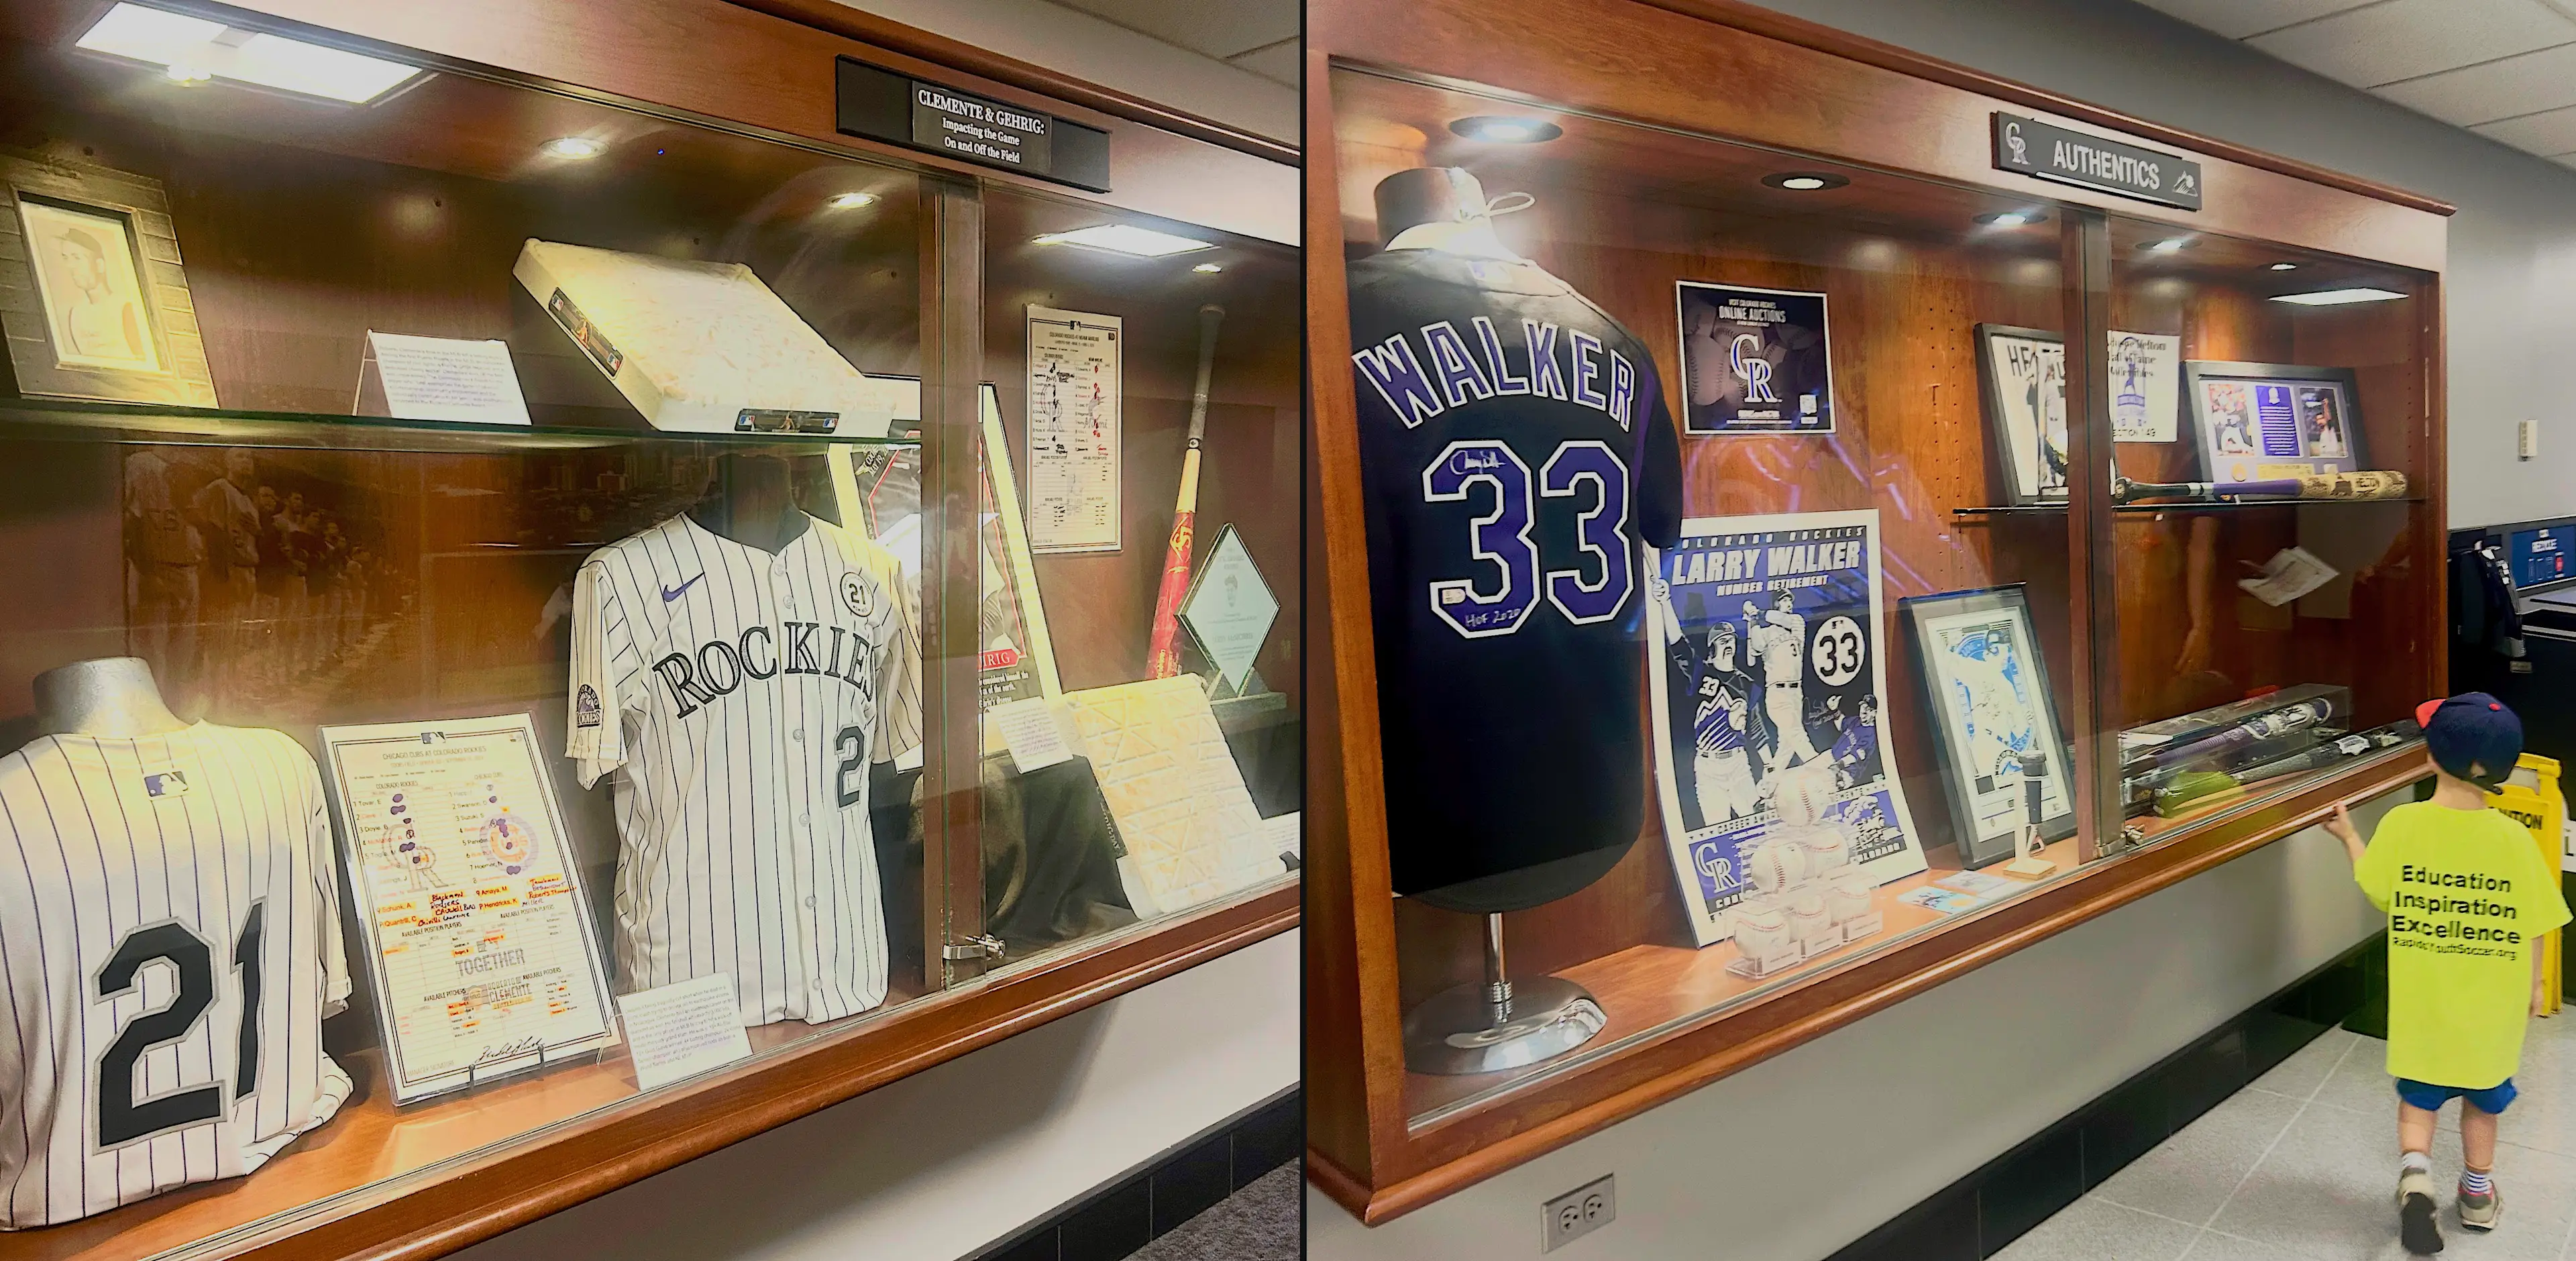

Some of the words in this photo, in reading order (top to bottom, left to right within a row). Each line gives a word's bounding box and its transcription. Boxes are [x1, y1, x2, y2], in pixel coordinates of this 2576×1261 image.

[918, 89, 983, 121] CLEMENTE
[985, 107, 995, 123] &
[996, 110, 1045, 135] GEHRIG:
[942, 117, 983, 140] Impacting
[983, 128, 998, 140] the
[998, 131, 1020, 146] Game
[944, 136, 957, 149] On
[957, 141, 973, 153] and
[973, 144, 987, 156] Off
[987, 146, 1000, 159] the
[1000, 149, 1020, 164] Field
[2053, 140, 2161, 190] AUTHENTICS
[1719, 306, 1748, 320] ONLINE
[1749, 309, 1786, 323] AUCTIONS
[1351, 316, 1635, 433] WALKER
[1730, 333, 1782, 402] CR
[1422, 439, 1635, 639] 33
[1682, 533, 1773, 549] OLORADO
[1789, 527, 1866, 542] ROCKIES
[1672, 547, 1762, 586] LARRY
[1767, 541, 1862, 578] WALKER
[849, 583, 865, 605] 21
[1716, 582, 1764, 596] NUMBER
[1766, 574, 1829, 592] RETIREMENT
[979, 651, 1012, 669] HRIG
[1819, 632, 1858, 677] 33
[652, 621, 875, 720] ROCKIES
[1699, 676, 1720, 697] 33
[382, 753, 409, 761] CHICAGO
[433, 748, 463, 757] COLORADO
[376, 781, 400, 789] COLORADO
[1717, 818, 1750, 834] CAREER
[1752, 811, 1779, 827] AWAR
[1695, 841, 1742, 894] CR
[2402, 865, 2512, 893] Education
[2394, 891, 2517, 920] Inspiration
[2392, 915, 2522, 944] Excellence
[455, 948, 526, 977] TOGETHER
[489, 983, 533, 1003] CLEMENTE
[92, 894, 268, 1156] 21
